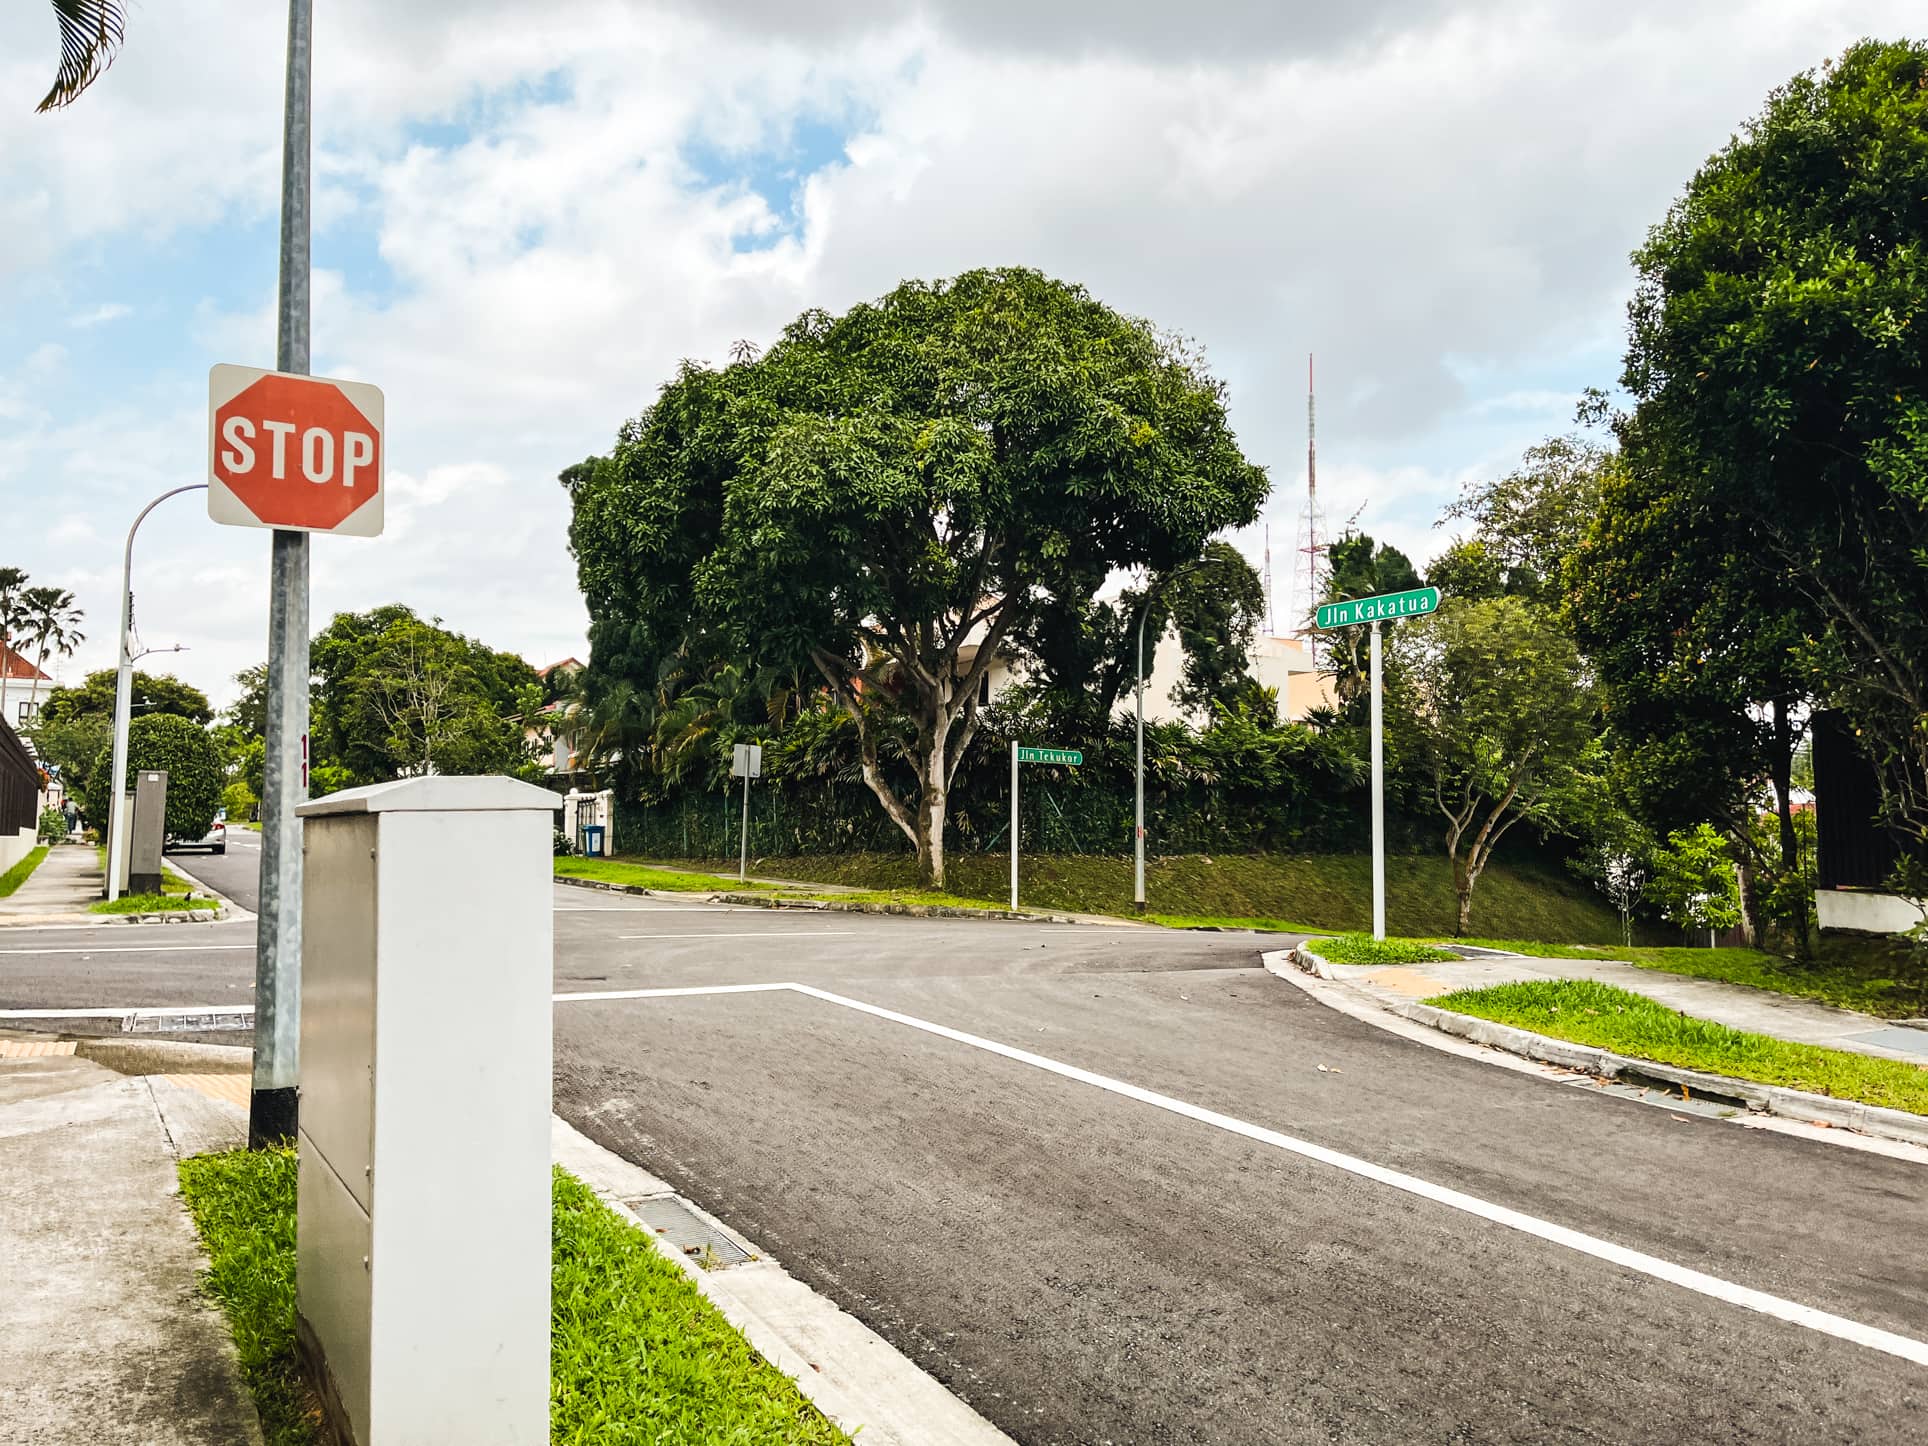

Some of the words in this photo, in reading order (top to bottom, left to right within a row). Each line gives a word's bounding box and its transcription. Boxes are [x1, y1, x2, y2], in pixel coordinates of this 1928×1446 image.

[221, 415, 374, 488] STOP
[1324, 606, 1348, 625] Jln
[1355, 596, 1429, 621] Kakatua
[1020, 749, 1035, 761] Jln
[1038, 750, 1078, 763] Tekukor
